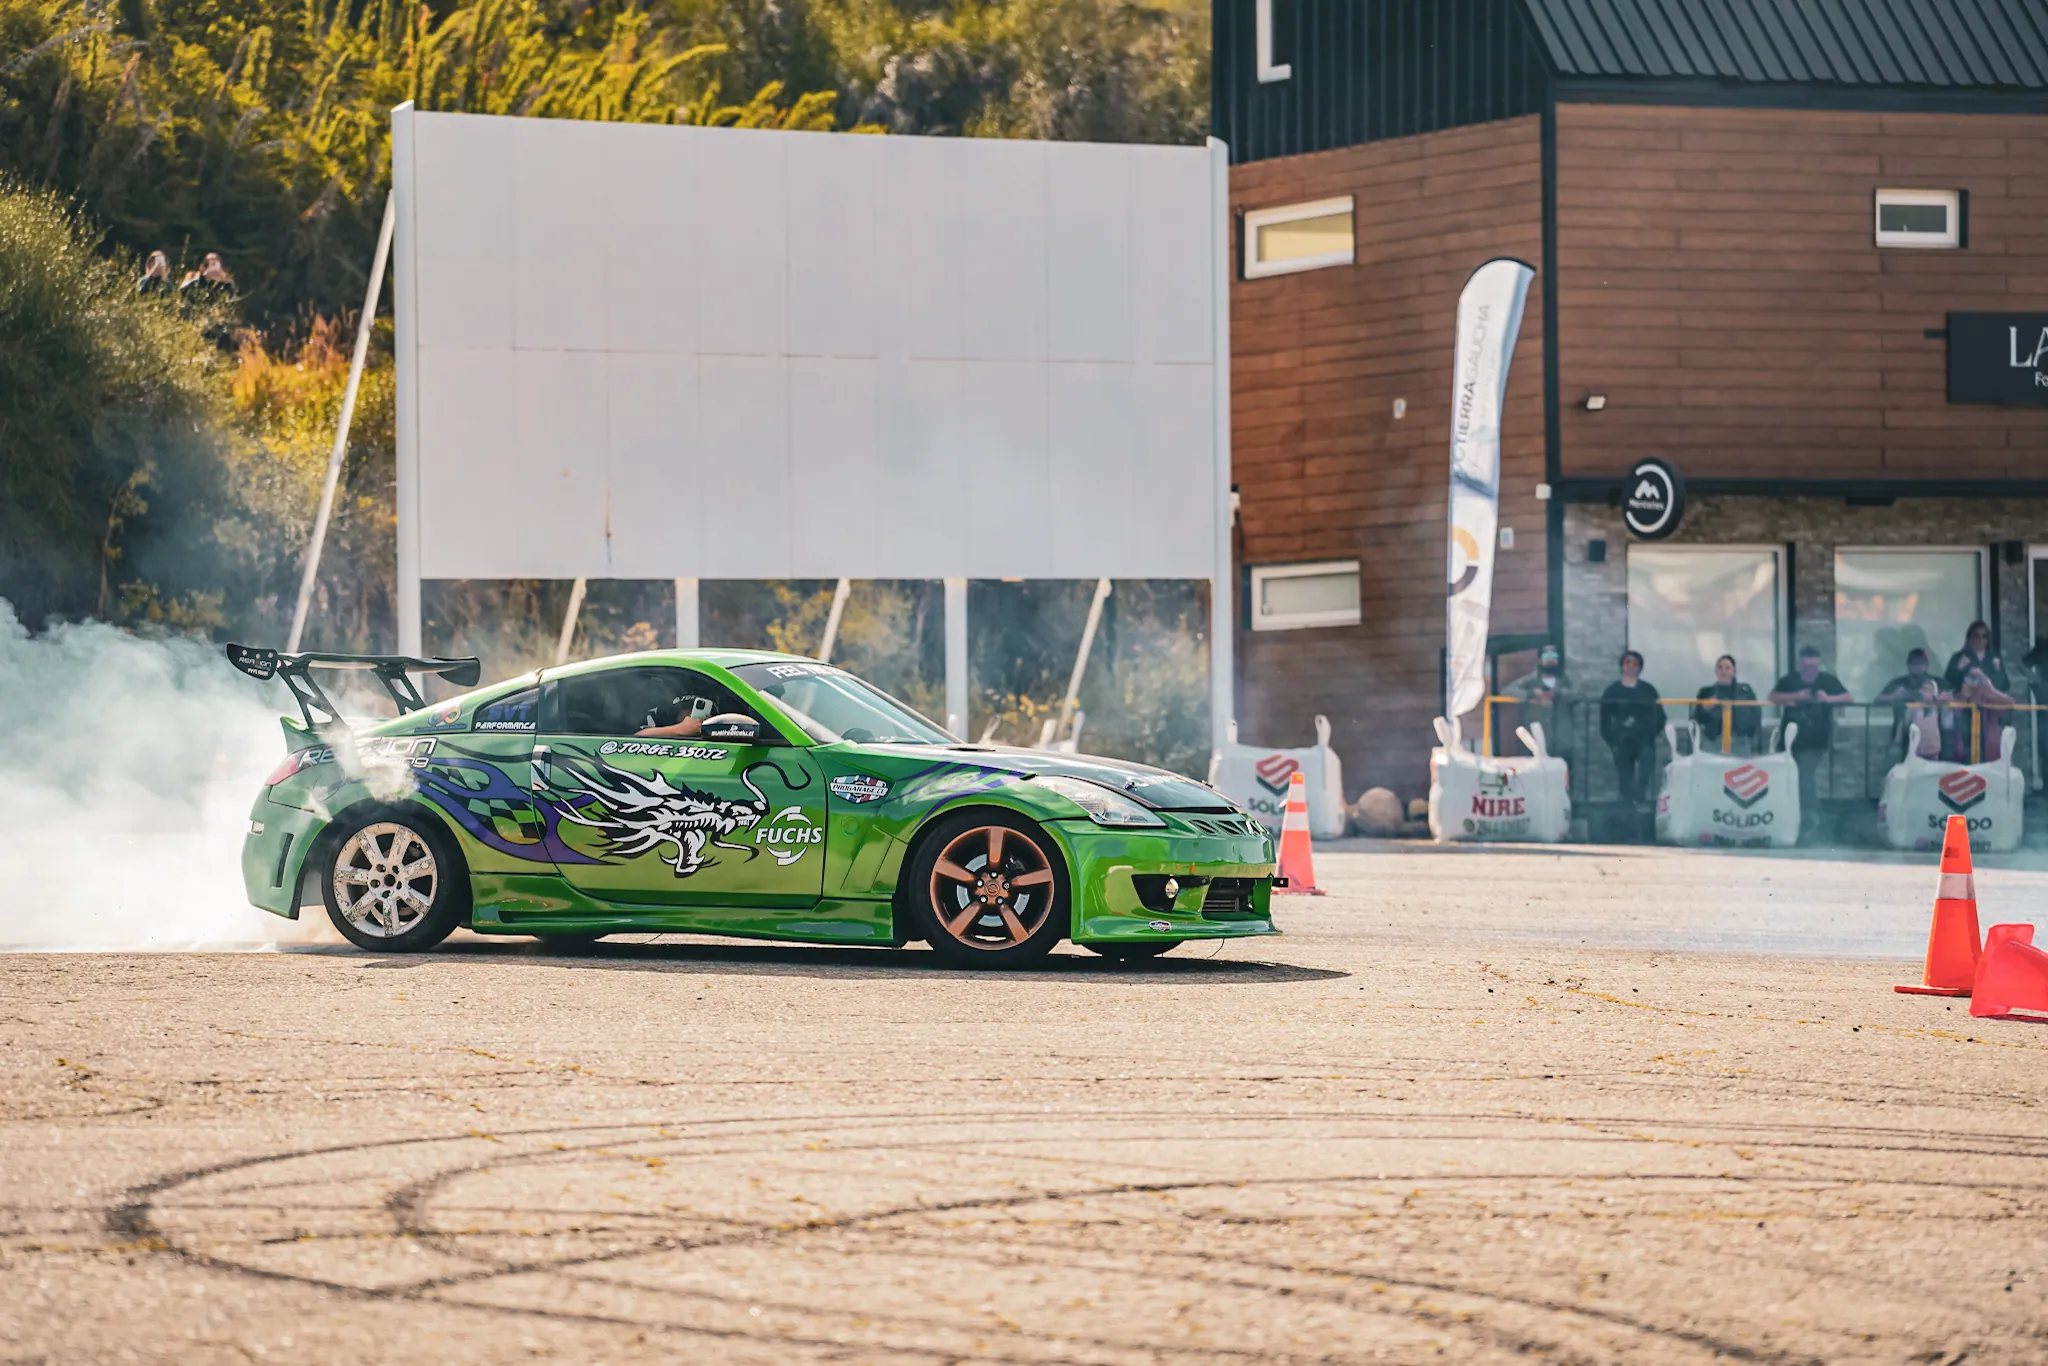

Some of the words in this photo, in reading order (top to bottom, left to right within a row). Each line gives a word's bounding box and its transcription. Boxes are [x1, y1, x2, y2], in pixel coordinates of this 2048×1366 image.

[766, 664, 808, 680] FEEL
[486, 704, 531, 721] SVT
[1471, 795, 1526, 818] NIRE
[755, 827, 823, 844] FUCHS
